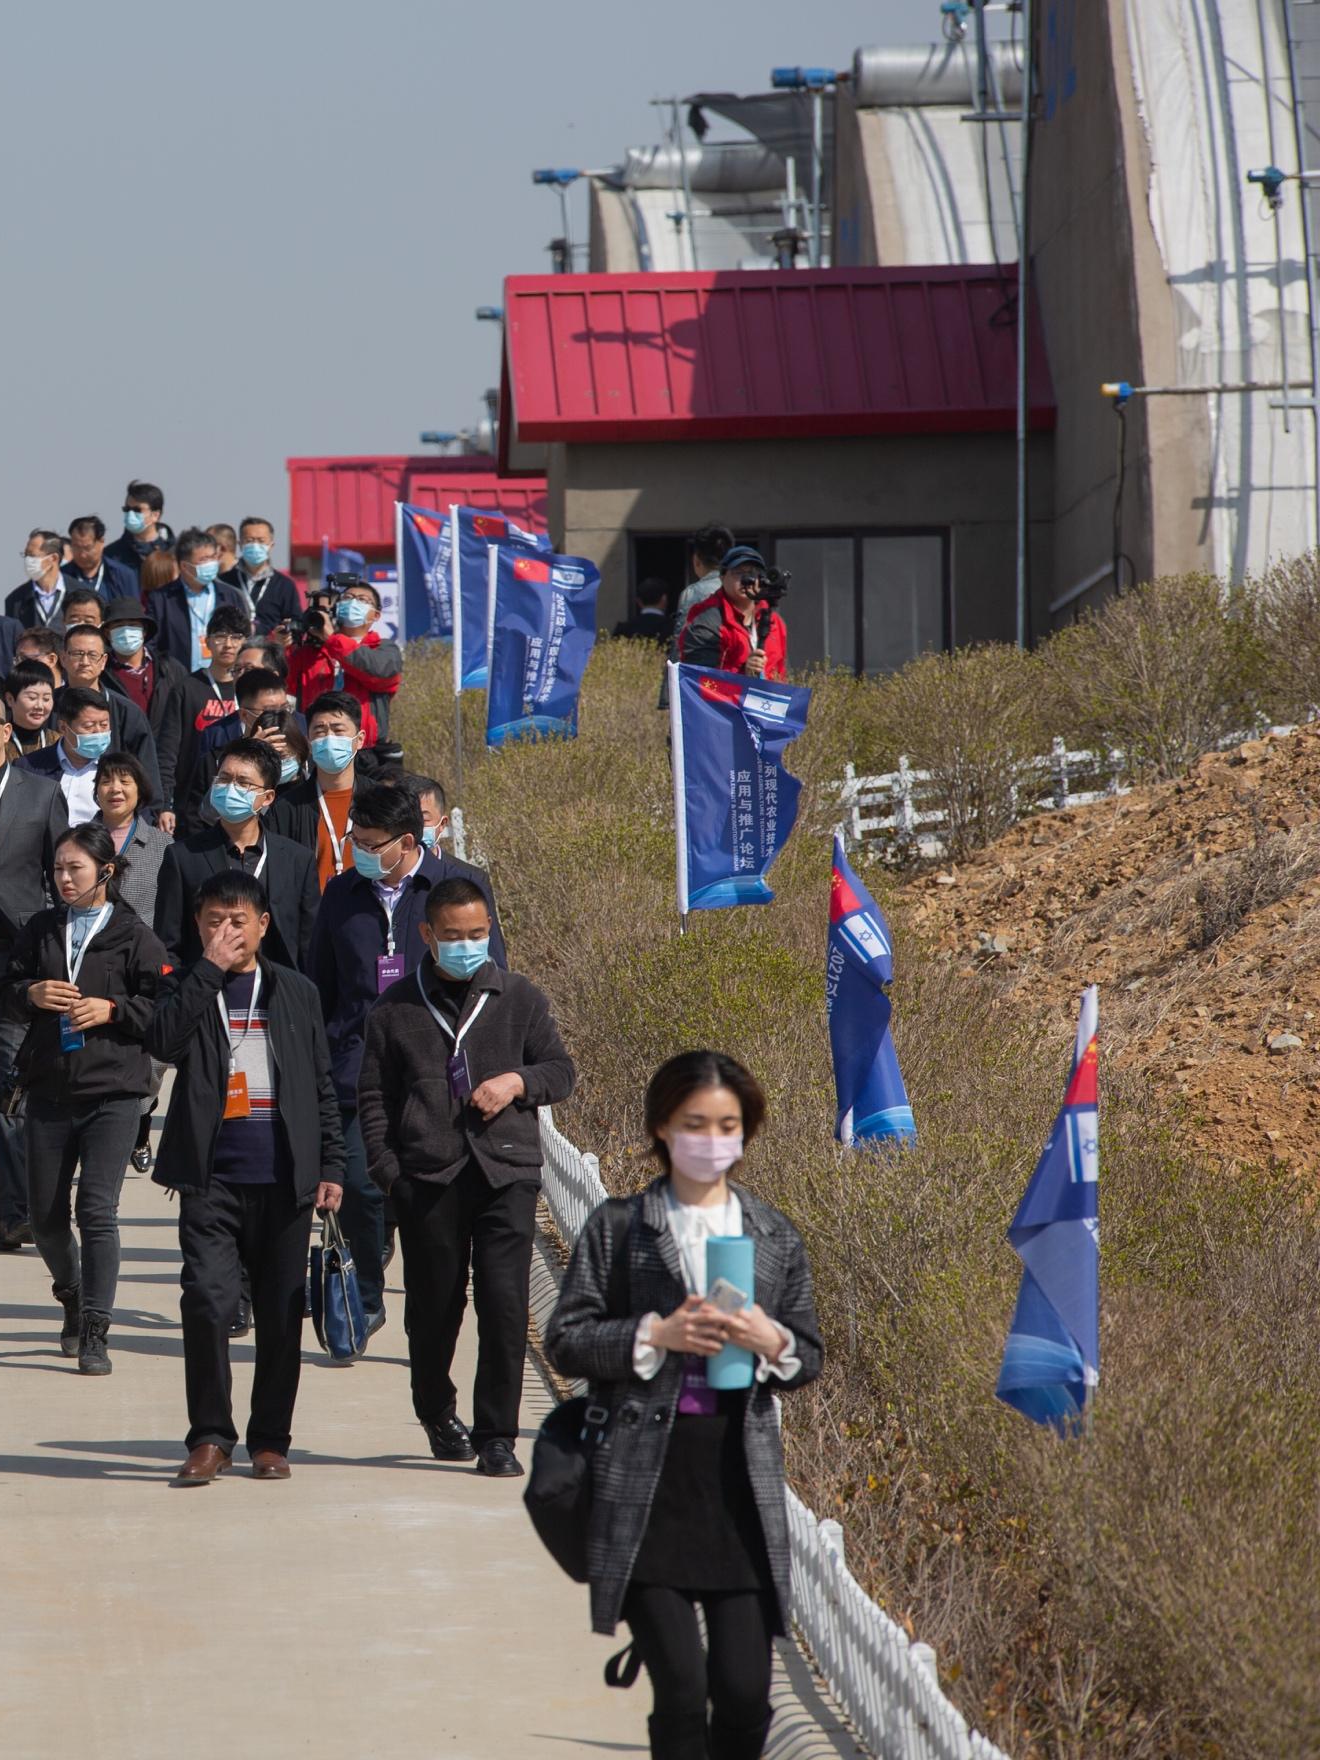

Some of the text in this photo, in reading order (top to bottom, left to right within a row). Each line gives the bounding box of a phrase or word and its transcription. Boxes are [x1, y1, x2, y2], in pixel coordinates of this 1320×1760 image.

[736, 769, 756, 869] 应用与推广论坛
